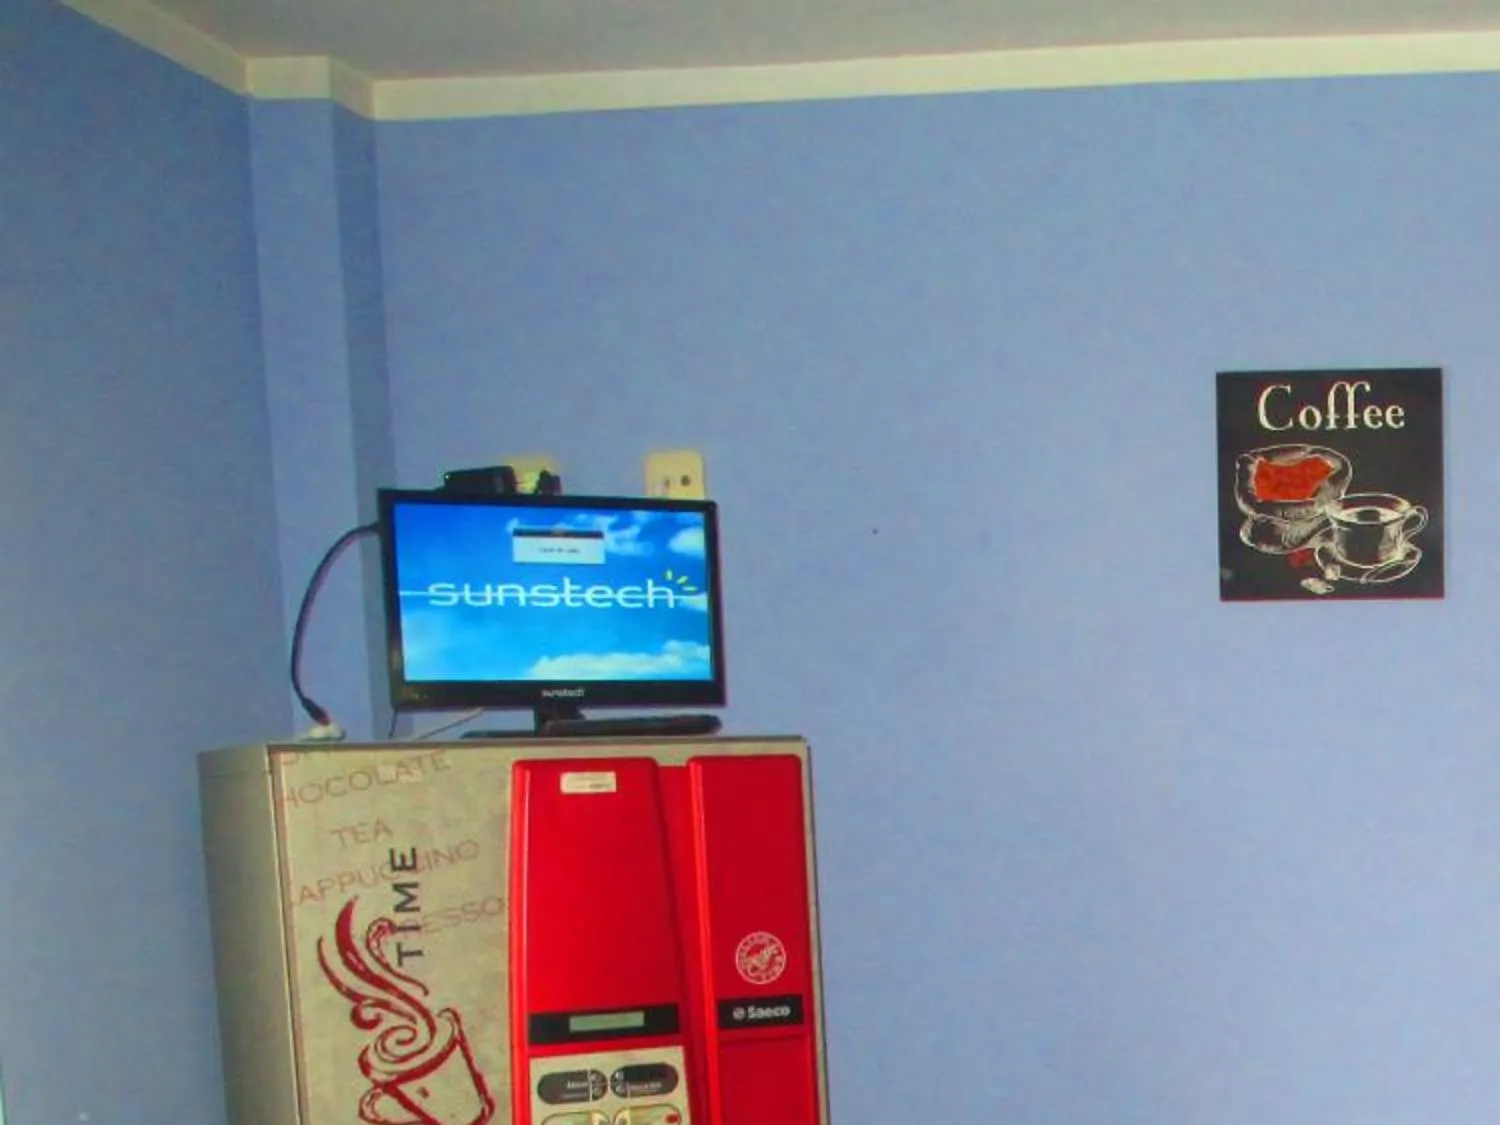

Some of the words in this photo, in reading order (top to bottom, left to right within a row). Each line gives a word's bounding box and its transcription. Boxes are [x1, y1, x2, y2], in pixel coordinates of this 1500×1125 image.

[1258, 381, 1406, 431] Coffee
[427, 577, 675, 609] sunstech
[330, 818, 393, 848] TEA
[389, 847, 424, 967] TIME
[747, 1005, 792, 1019] Saeco
